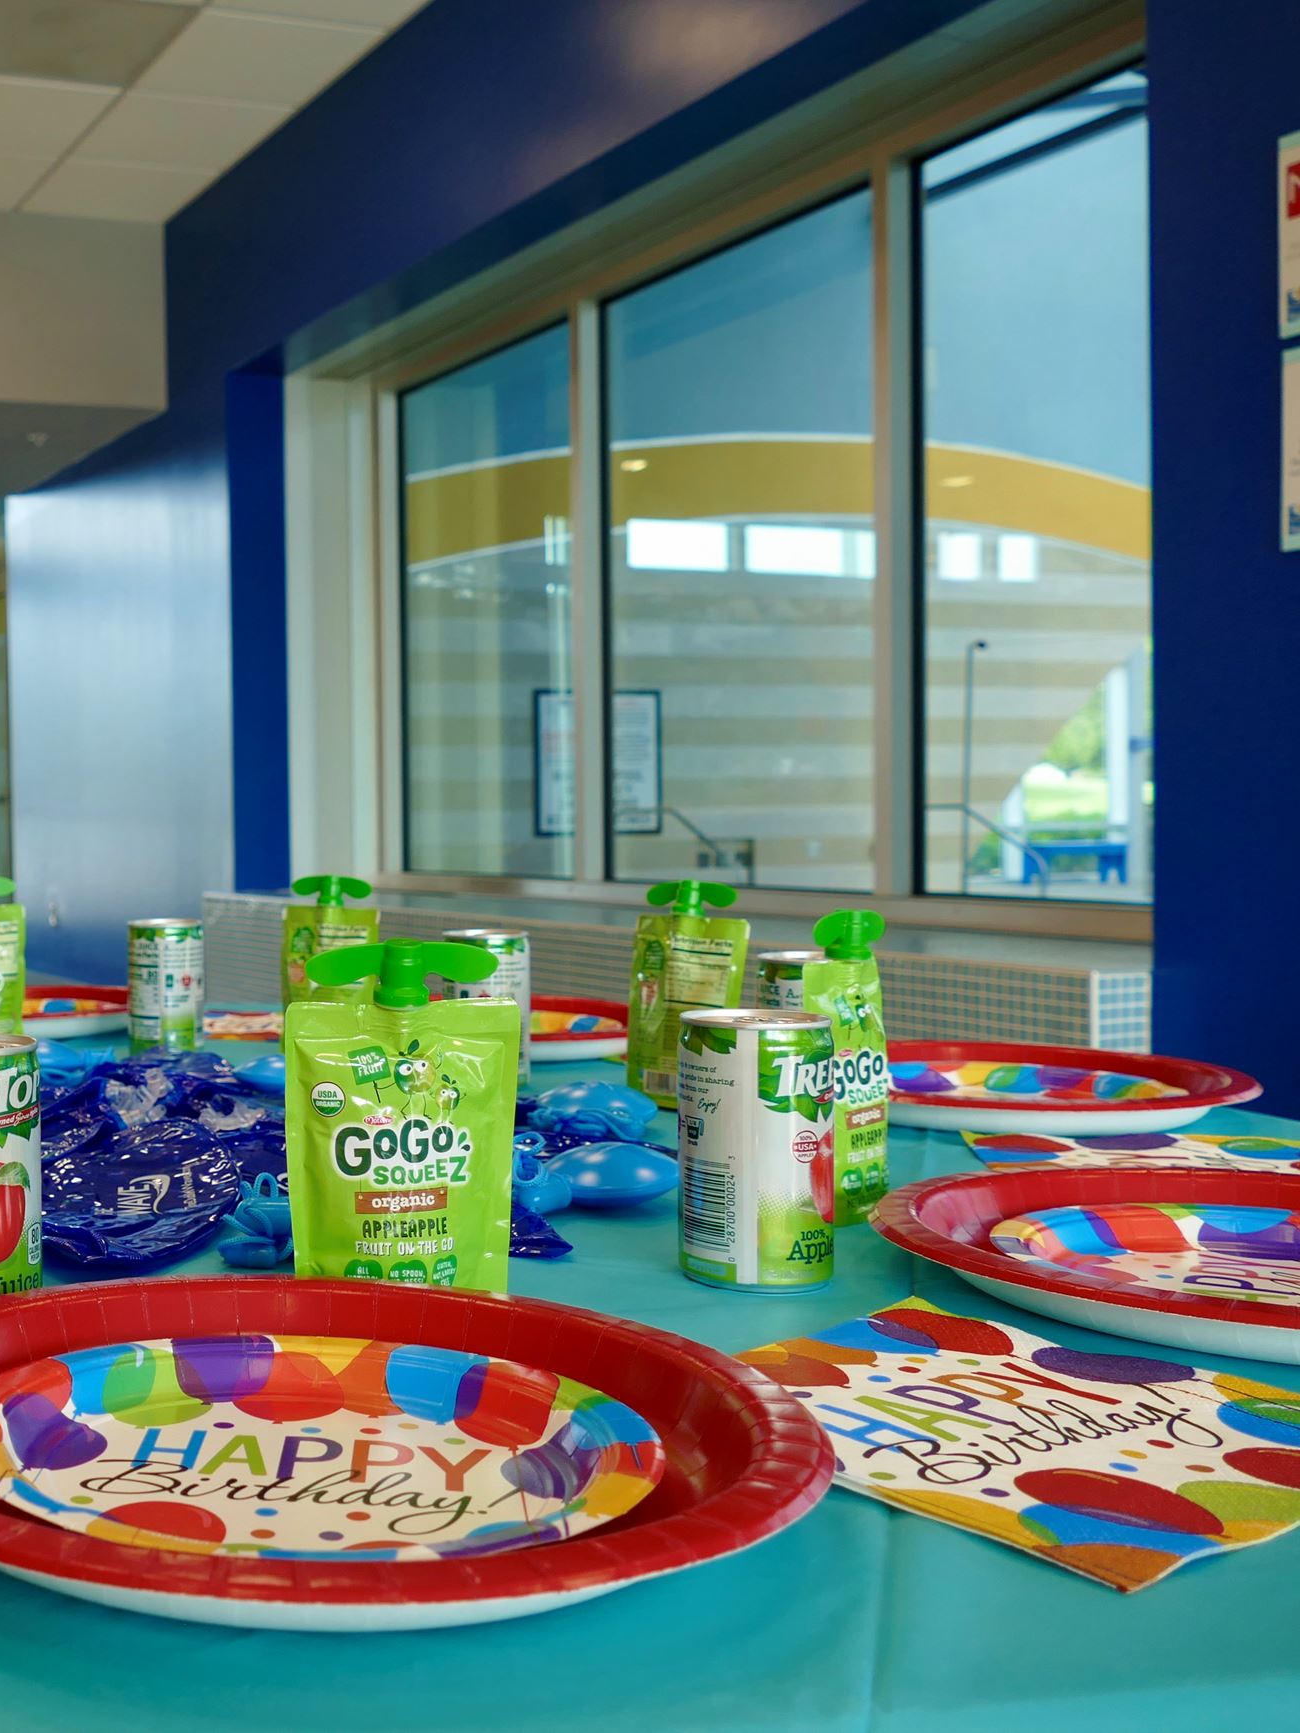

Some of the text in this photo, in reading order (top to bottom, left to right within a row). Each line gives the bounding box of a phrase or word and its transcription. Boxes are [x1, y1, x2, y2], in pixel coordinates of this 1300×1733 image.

[356, 1051, 381, 1065] 100%
[357, 1060, 385, 1077] FRUIT
[704, 1077, 735, 1087] sharing
[317, 1090, 338, 1099] USDA
[697, 1097, 722, 1114] Enjoy!
[798, 1143, 814, 1151] USA
[726, 1174, 736, 1207] 00024
[117, 1184, 152, 1217] WAVE
[371, 1192, 436, 1212] organic
[362, 1216, 448, 1239] APPLEAPPLE
[726, 1210, 736, 1244] 28700
[800, 1229, 826, 1241] 100%
[355, 1237, 455, 1256] FRUIT ON THE GO
[356, 1266, 370, 1275] ALL
[389, 1270, 400, 1278] NO
[401, 1269, 426, 1279] SPOON,
[814, 1361, 1123, 1454] HAPPY
[862, 1382, 1225, 1486] Birthday!
[129, 1427, 493, 1493] HAPPY
[78, 1458, 526, 1537] Birthday!
